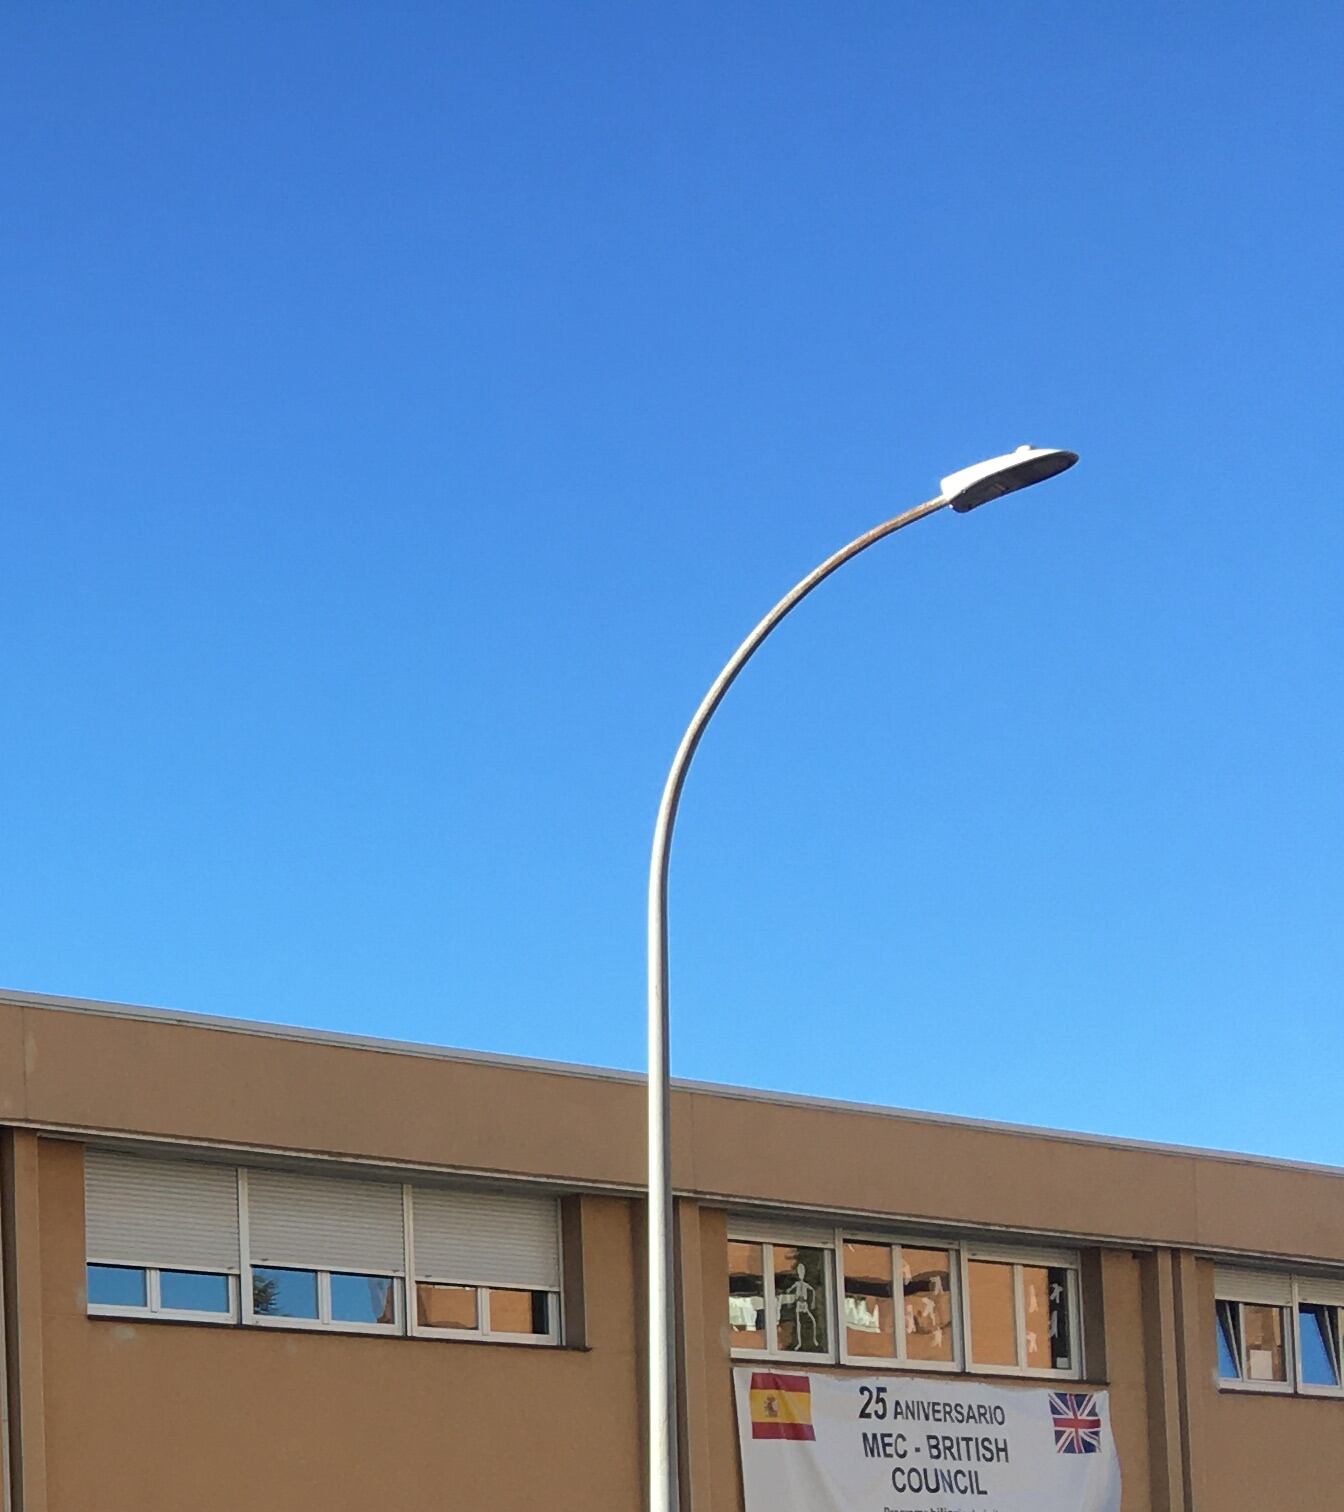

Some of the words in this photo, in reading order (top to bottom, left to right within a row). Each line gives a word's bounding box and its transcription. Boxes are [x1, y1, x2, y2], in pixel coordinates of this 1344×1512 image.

[858, 1385, 888, 1420] 25
[893, 1399, 1006, 1426] ANIVERSARIO
[862, 1431, 908, 1459] MEC
[928, 1434, 1010, 1464] BRITISH
[891, 1466, 988, 1496] COUNCIL
